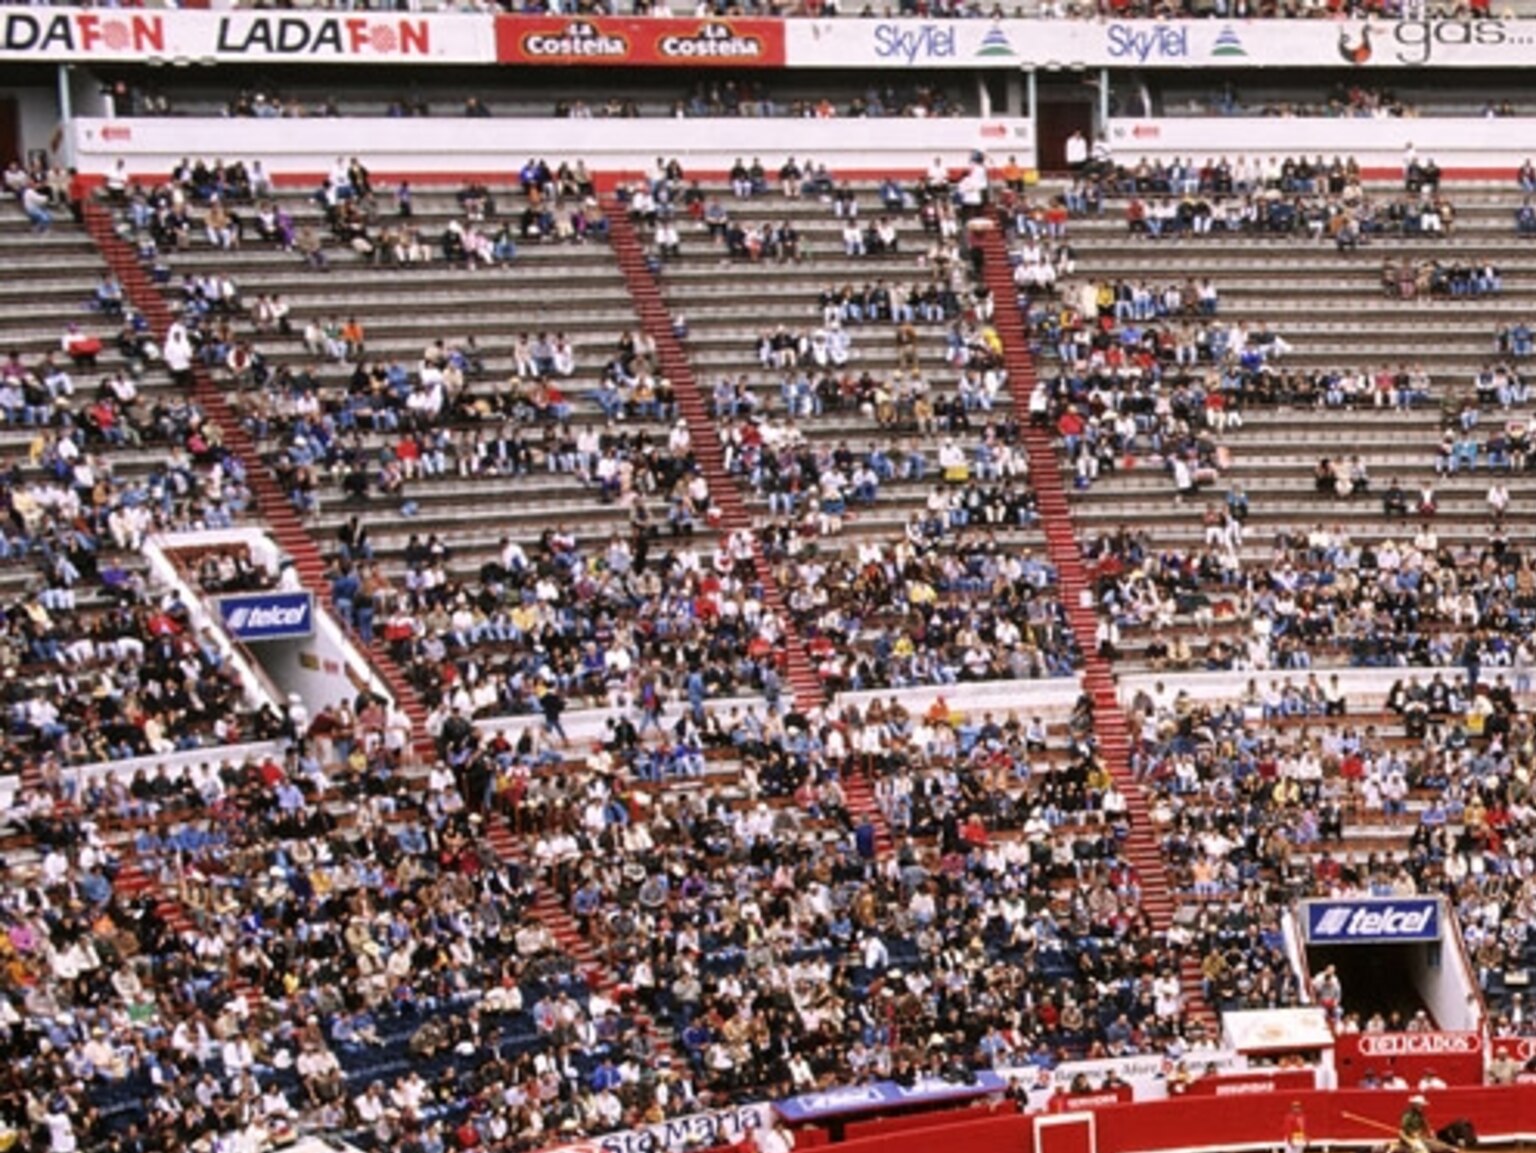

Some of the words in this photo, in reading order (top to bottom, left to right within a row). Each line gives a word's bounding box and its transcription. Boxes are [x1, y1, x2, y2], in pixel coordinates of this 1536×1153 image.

[874, 23, 956, 63] SkyTel
[1107, 23, 1188, 63] SkyTel
[248, 604, 306, 629] telcel
[1346, 905, 1434, 933] telcel
